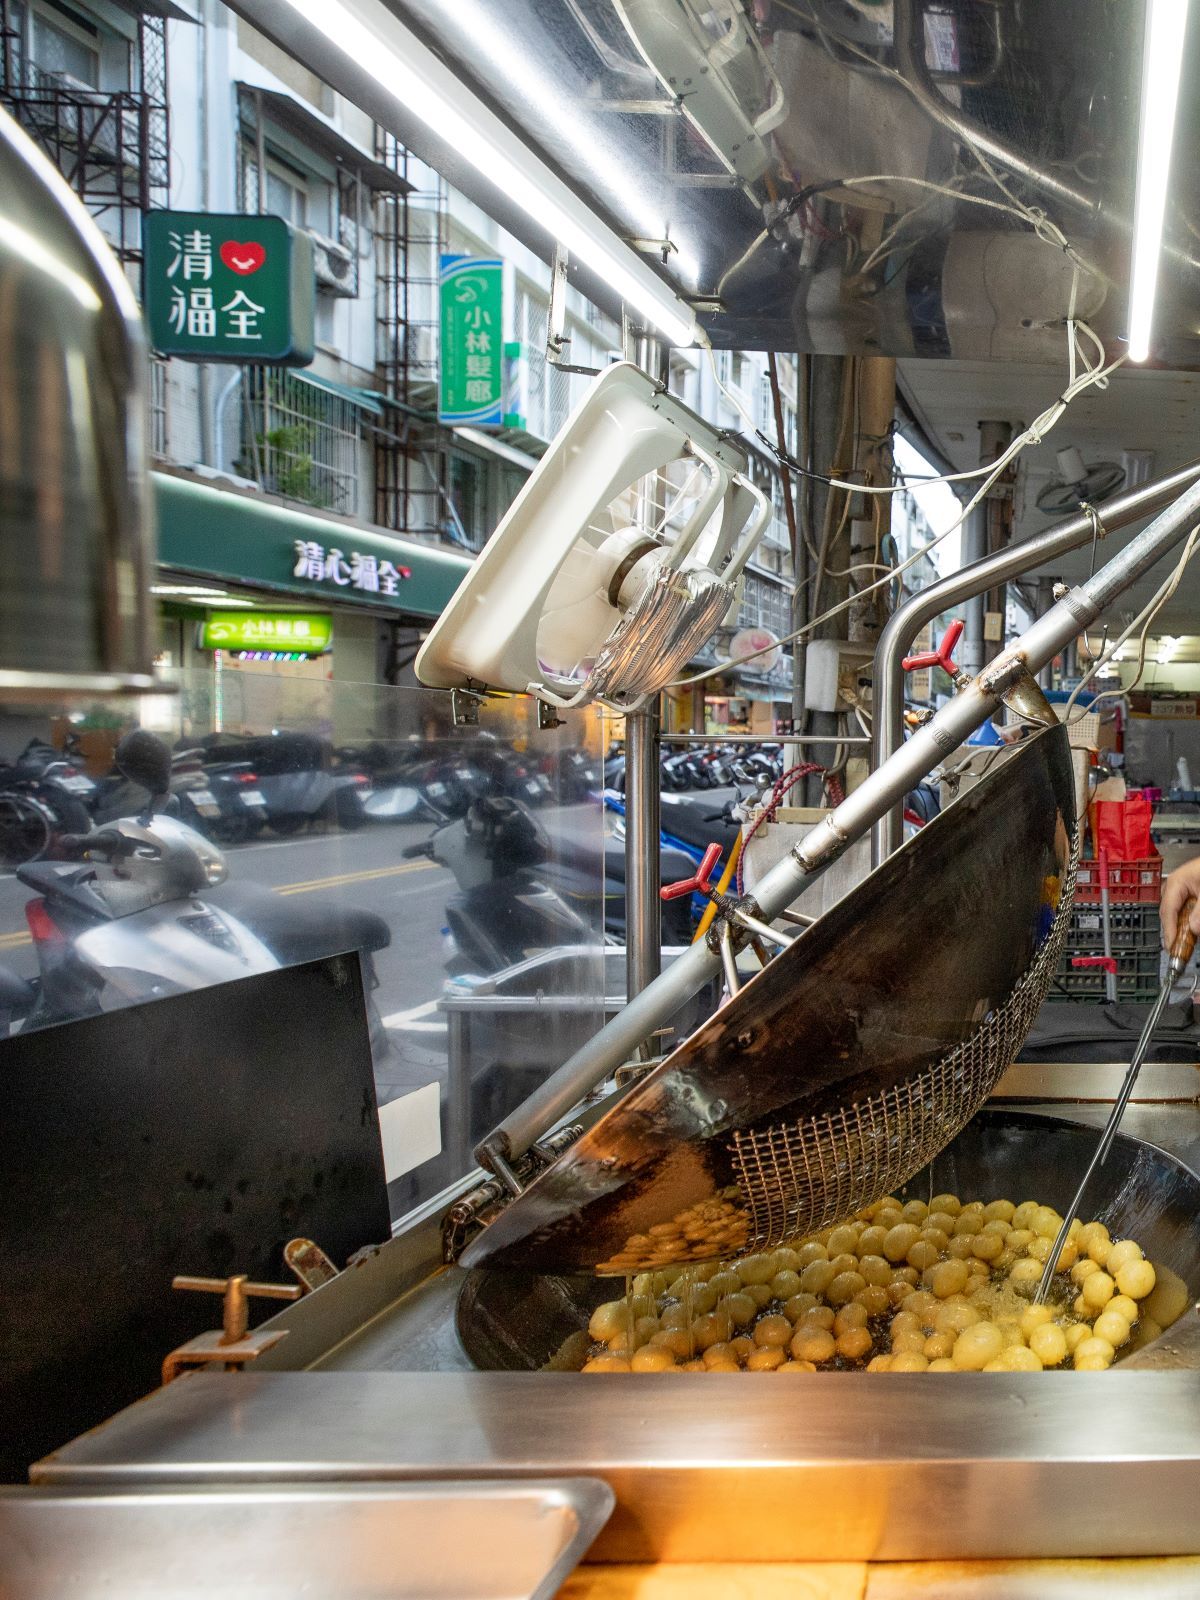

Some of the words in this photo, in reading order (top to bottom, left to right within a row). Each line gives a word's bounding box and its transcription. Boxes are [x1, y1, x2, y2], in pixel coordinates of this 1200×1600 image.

[166, 229, 213, 281] 清
[167, 284, 266, 340] 福全
[464, 305, 492, 403] 小林髮廊
[293, 539, 401, 597] 清心福全
